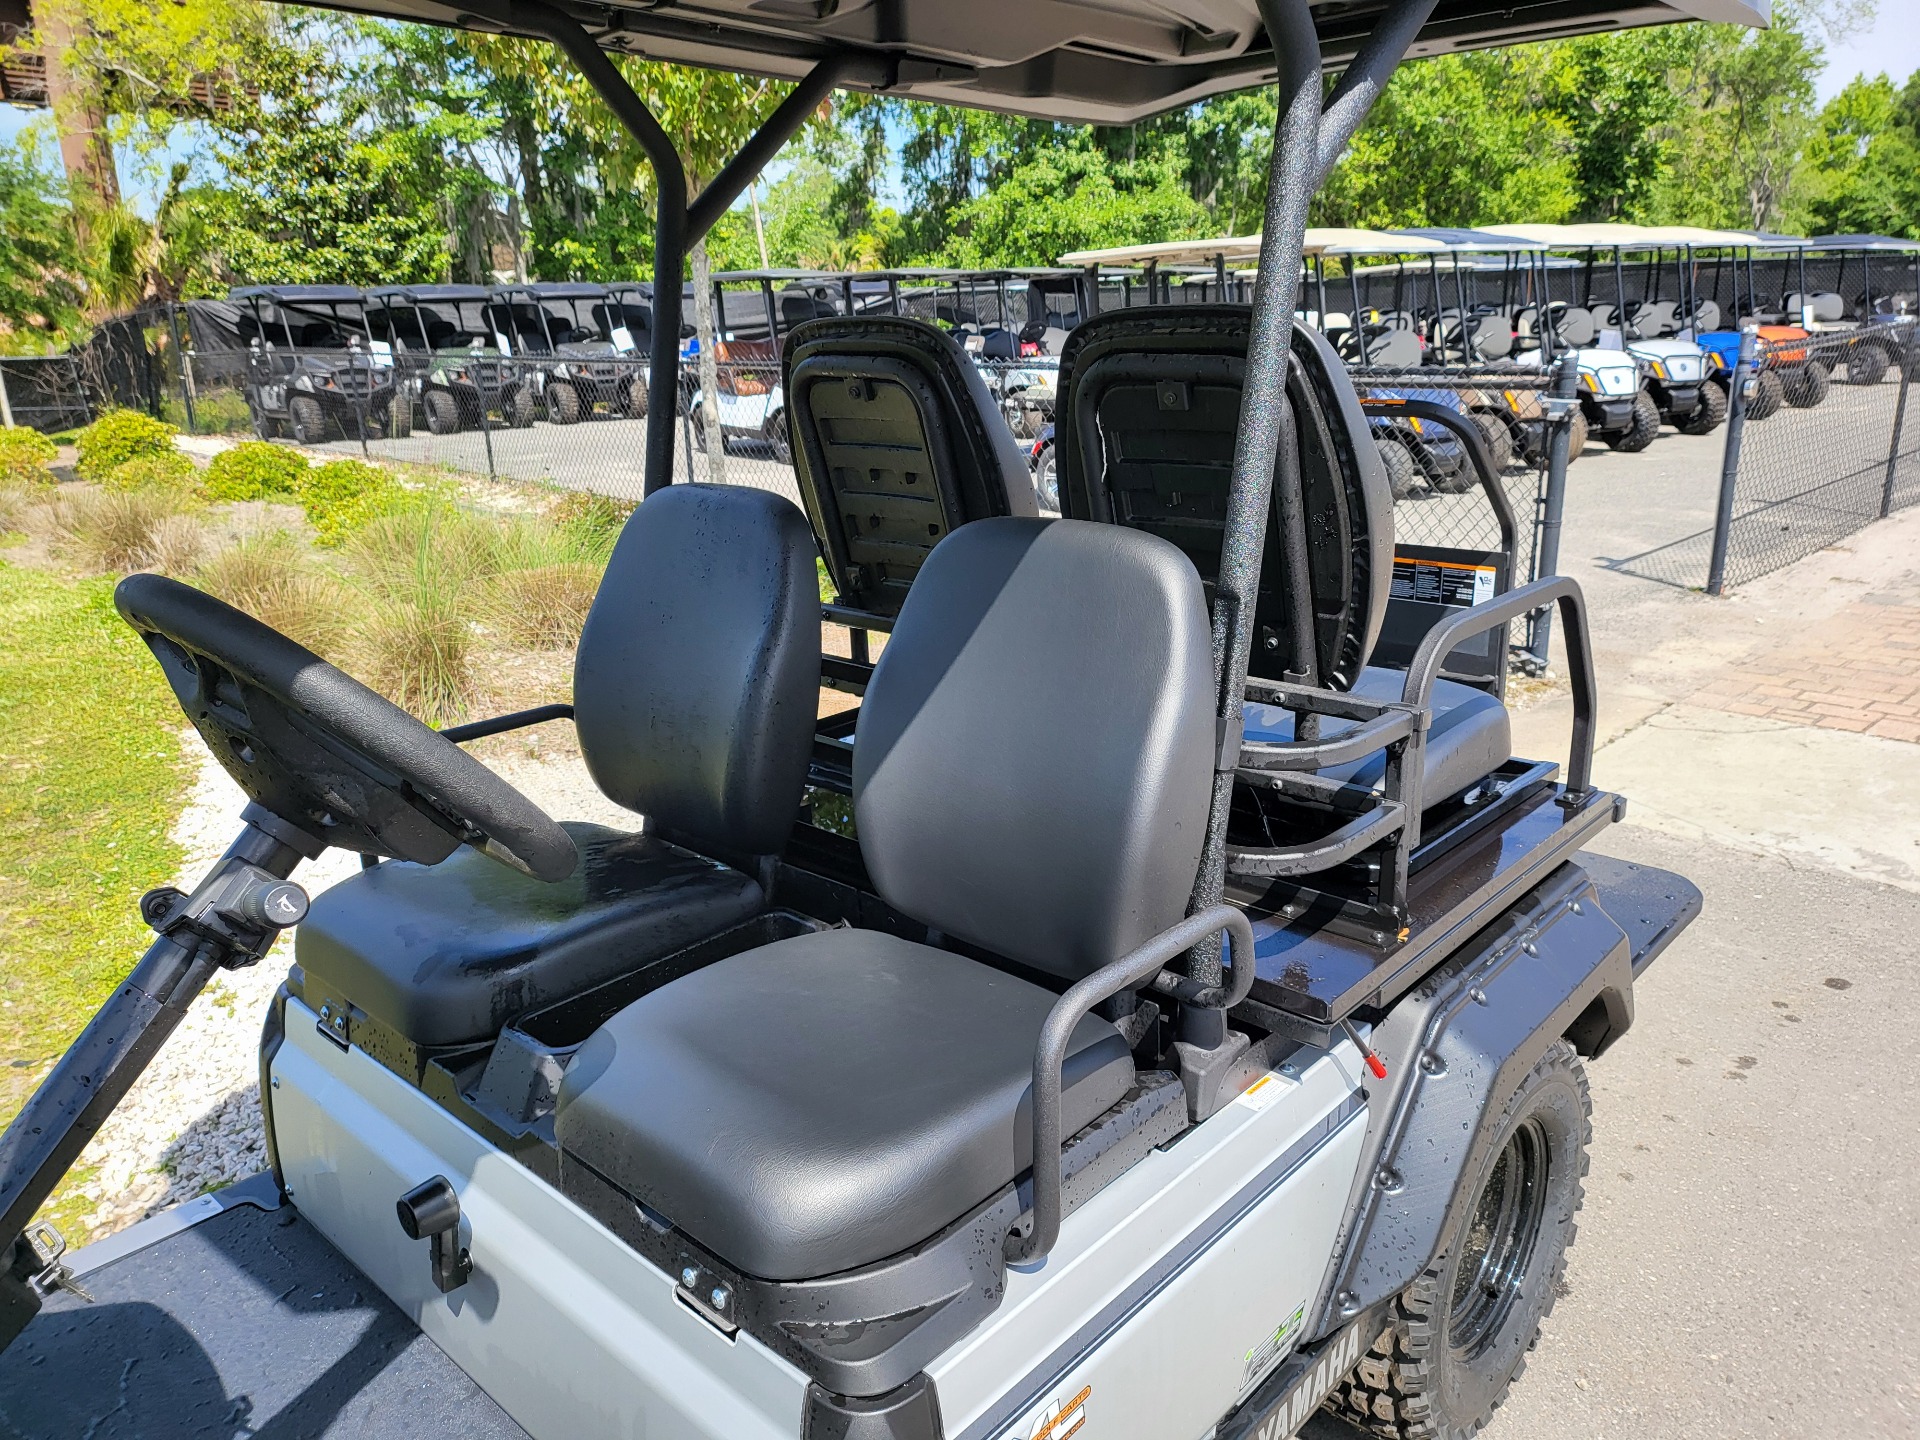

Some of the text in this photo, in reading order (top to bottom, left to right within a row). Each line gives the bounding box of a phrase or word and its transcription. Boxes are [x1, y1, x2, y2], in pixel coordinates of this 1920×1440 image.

[1036, 1418, 1059, 1440] GOLF
[1060, 1388, 1089, 1419] CARTS
[1258, 1323, 1359, 1440] YAMAHA
